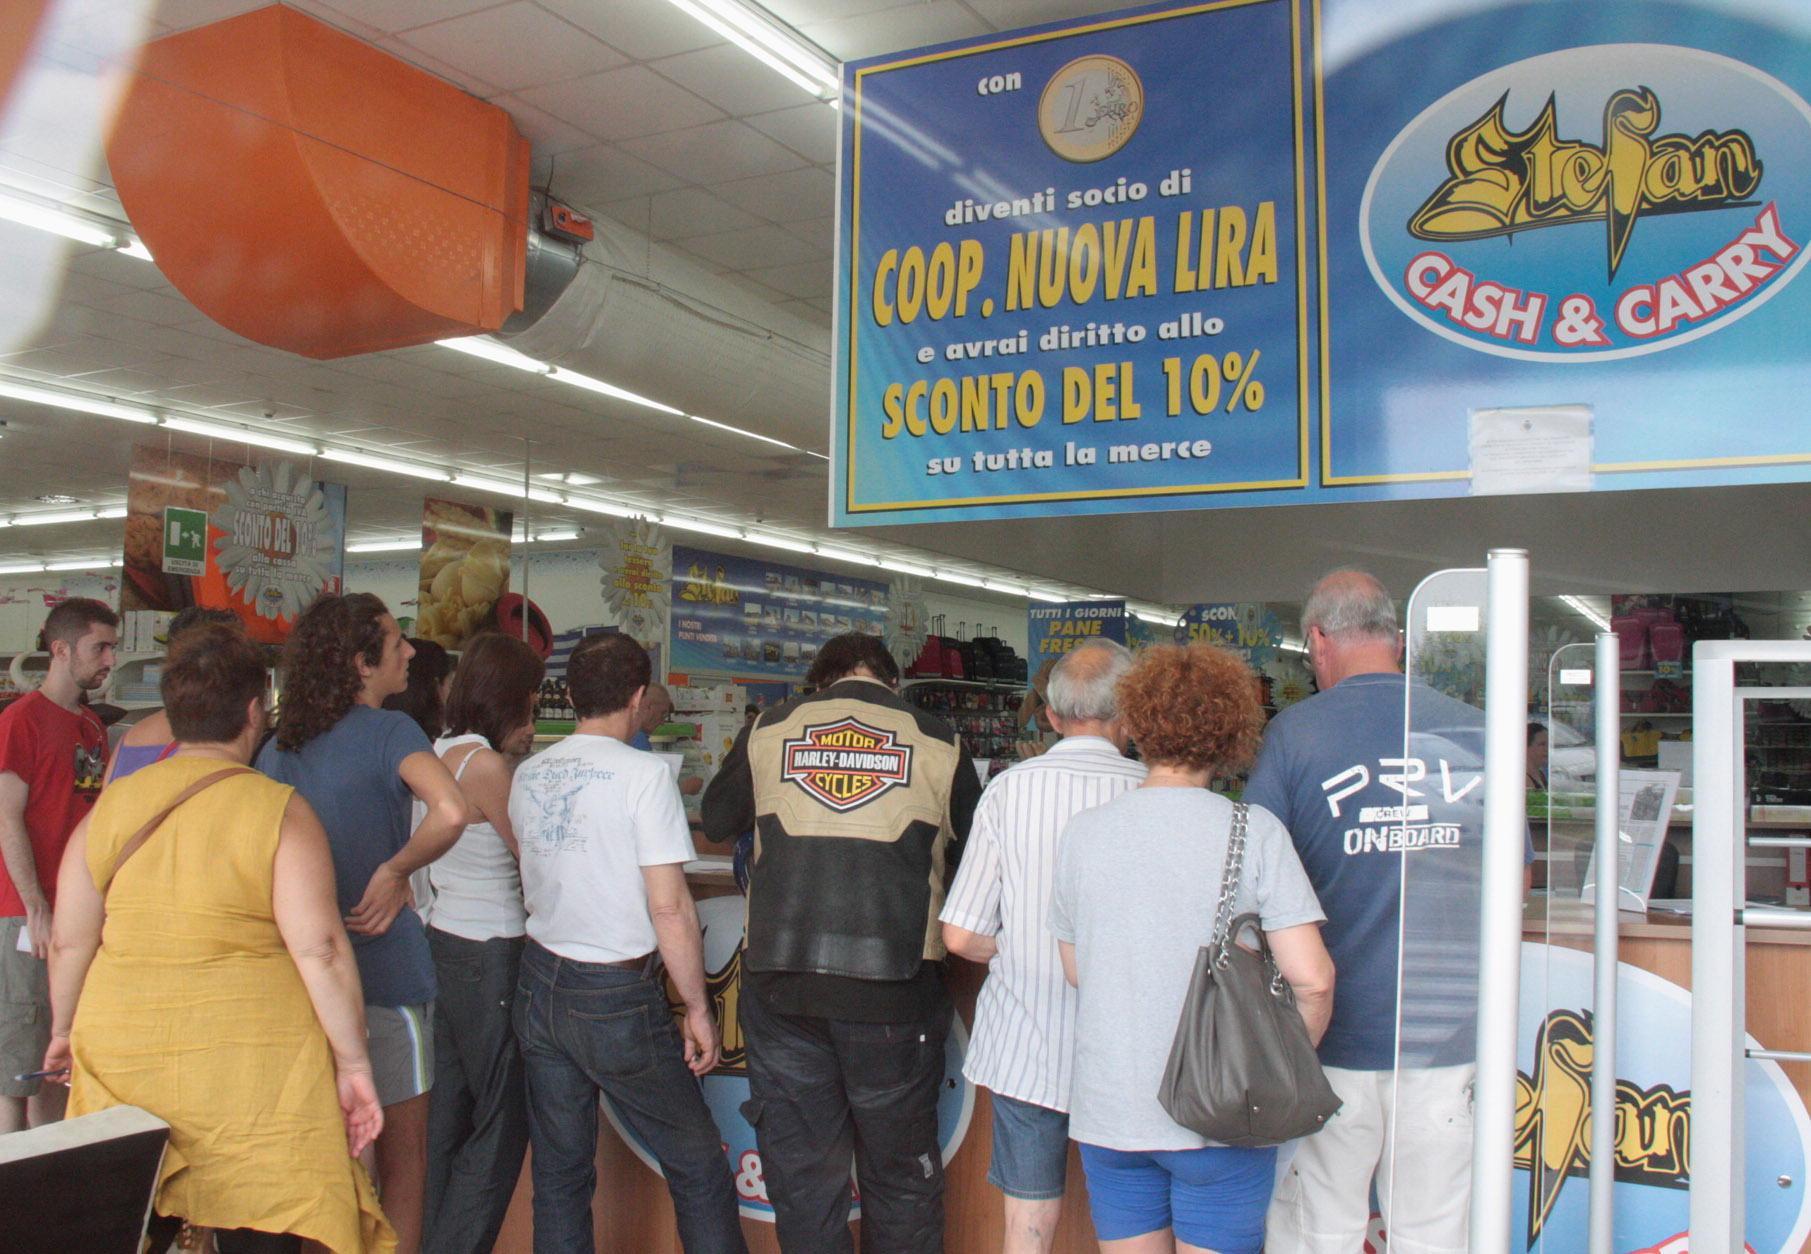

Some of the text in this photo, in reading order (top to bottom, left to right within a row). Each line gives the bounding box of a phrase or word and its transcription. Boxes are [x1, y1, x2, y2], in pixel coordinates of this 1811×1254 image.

[977, 71, 1022, 96] con
[945, 169, 1192, 225] diventi socio di
[1406, 84, 1764, 287] Stefan
[873, 201, 1278, 327] COOP. NUOVA LIRA
[1404, 202, 1800, 346] CASH & CARRY
[917, 312, 1224, 364] e avrai diritto allo
[882, 349, 1265, 439] SCONTO DEL 10%
[926, 439, 1212, 475] su tutta la merce
[233, 511, 272, 550] SCONTO
[274, 517, 292, 554] DEL
[1030, 607, 1121, 619] TUTTI I GIORNI
[1202, 606, 1238, 621] SCON
[1049, 621, 1103, 636] PANE
[821, 729, 875, 748] MOTOR
[794, 751, 899, 771] HARLEY-DAVIDSON
[815, 773, 872, 798] CYCLES
[1376, 809, 1410, 819] CREW
